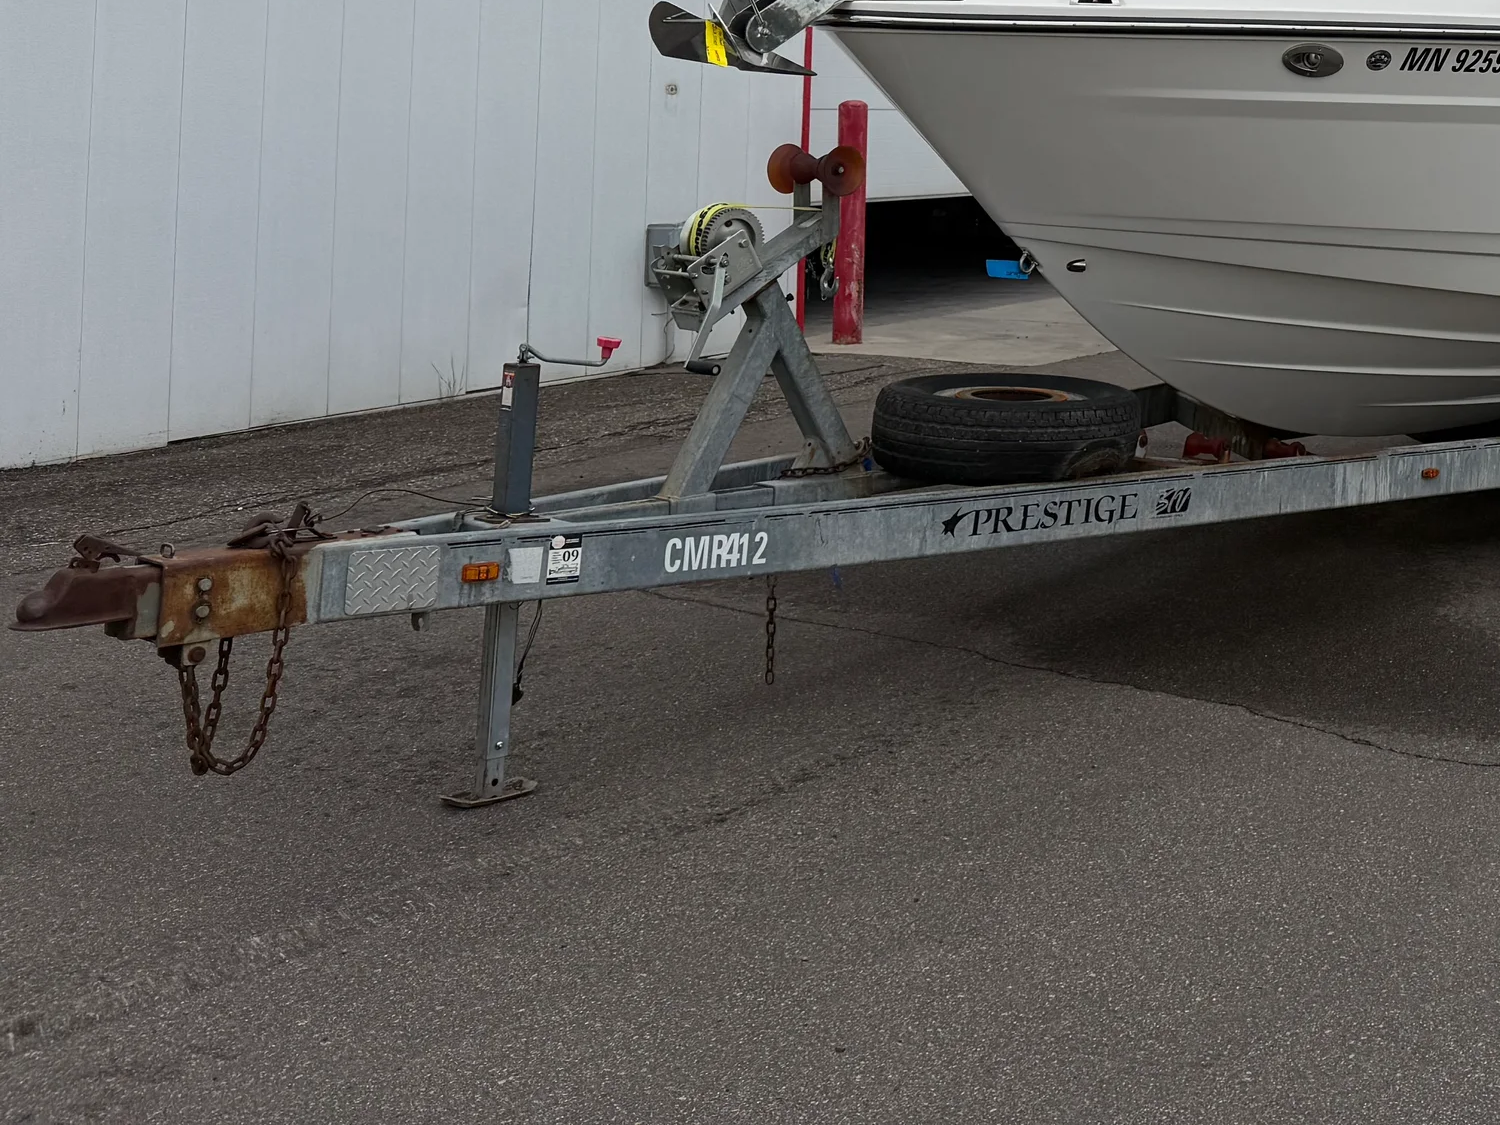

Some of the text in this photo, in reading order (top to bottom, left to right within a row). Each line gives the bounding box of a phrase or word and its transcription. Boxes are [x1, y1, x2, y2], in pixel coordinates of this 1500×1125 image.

[1399, 47, 1451, 71] MN
[967, 493, 1138, 537] PRESTIGE
[563, 549, 579, 562] 09
